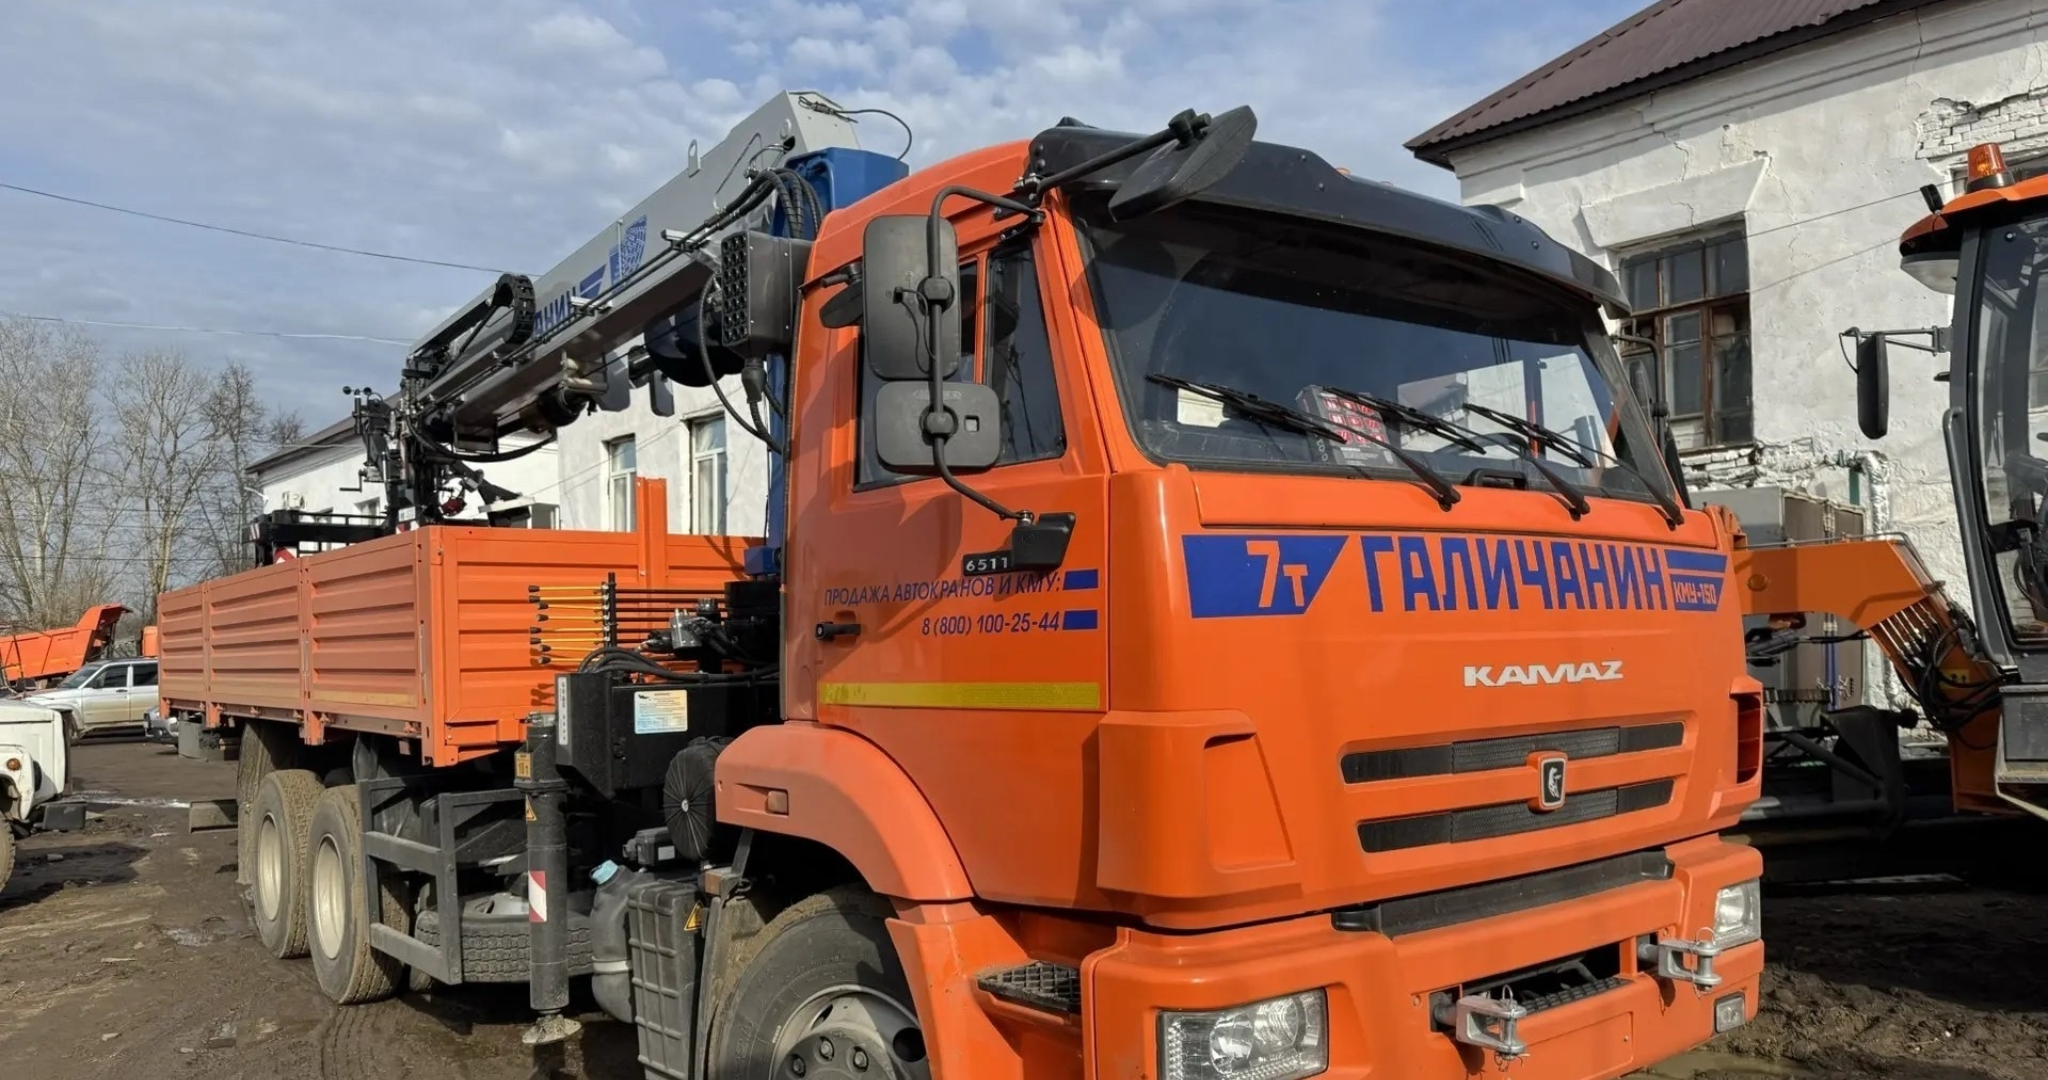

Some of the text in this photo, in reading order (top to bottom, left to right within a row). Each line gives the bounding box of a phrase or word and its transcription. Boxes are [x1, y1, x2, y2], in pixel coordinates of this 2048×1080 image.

[965, 556, 1008, 572] 6511
[1359, 534, 1669, 612] ГАЛИЧАНИН
[824, 570, 1061, 606] ПРОДАЖА АВТОКРАНОВ И КМУ:
[1673, 581, 1718, 605] КМУ-150
[922, 611, 1060, 637] 8 (800) 100-25-44
[1463, 660, 1624, 687] KAMAZ
